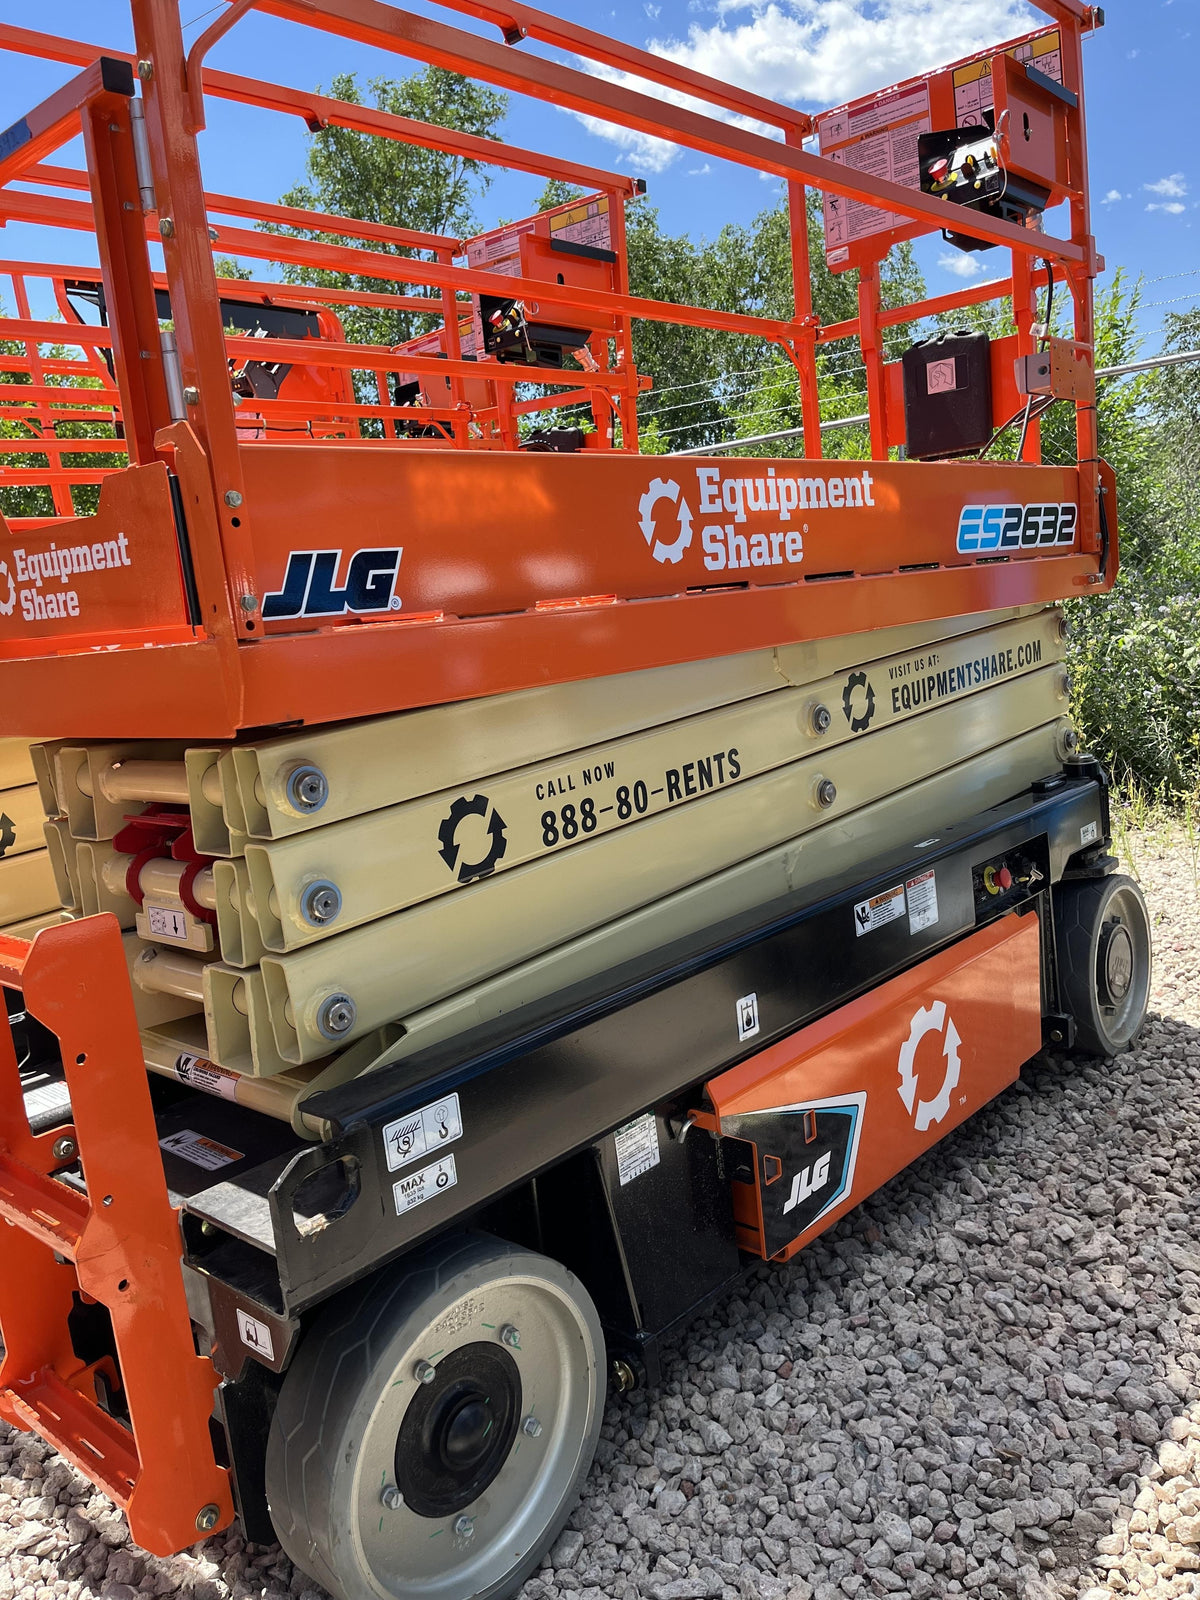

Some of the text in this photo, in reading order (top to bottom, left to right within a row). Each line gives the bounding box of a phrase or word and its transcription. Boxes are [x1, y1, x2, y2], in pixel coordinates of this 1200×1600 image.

[696, 467, 875, 523] Equipment
[702, 524, 804, 571] Share
[956, 503, 1078, 554] ES2632
[13, 532, 132, 587] Equipment
[262, 547, 403, 621] JLG
[21, 588, 80, 621] Share
[888, 654, 940, 680] VISIT US AT:
[891, 639, 1042, 713] EQUIPMENTSHARE.COM
[535, 761, 616, 800] CALL NOW
[540, 748, 742, 847] 888-80-RENTS
[400, 1173, 426, 1195] MAX
[417, 1193, 424, 1201] kg
[782, 1150, 832, 1215] JLG
